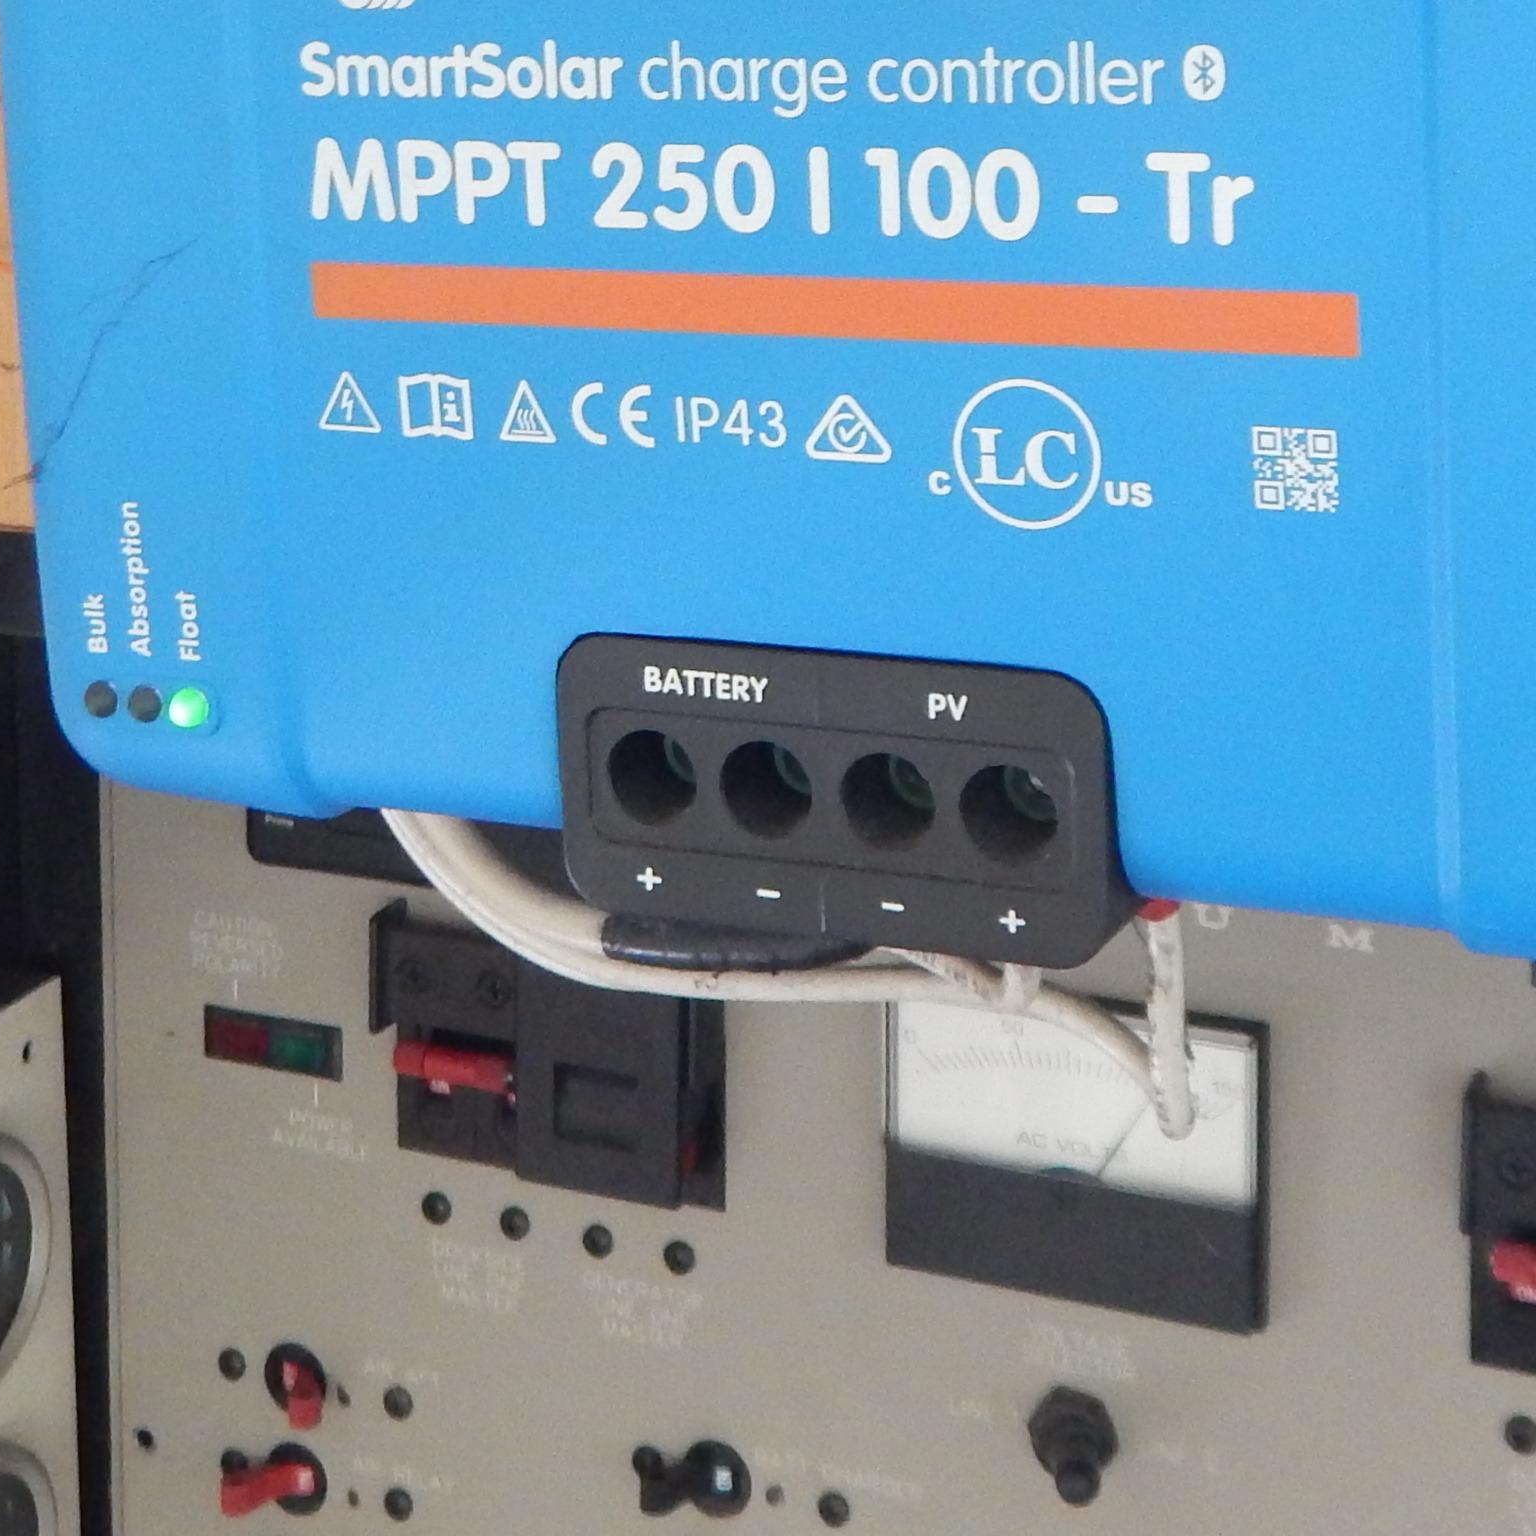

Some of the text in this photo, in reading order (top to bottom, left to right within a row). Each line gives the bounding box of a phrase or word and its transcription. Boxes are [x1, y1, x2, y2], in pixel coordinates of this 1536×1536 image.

[299, 39, 1165, 119] SmartSolar charge controller
[310, 137, 561, 227] MPPT
[591, 141, 776, 234] 250
[864, 146, 1041, 241] 100
[1145, 151, 1255, 246] Tr
[675, 396, 787, 448] IP43
[972, 427, 1079, 493] LC
[119, 501, 152, 657] Absorption
[82, 594, 109, 654] Bulk
[174, 590, 202, 662] Float
[643, 665, 768, 703] BATTERY
[928, 692, 968, 721] PV
